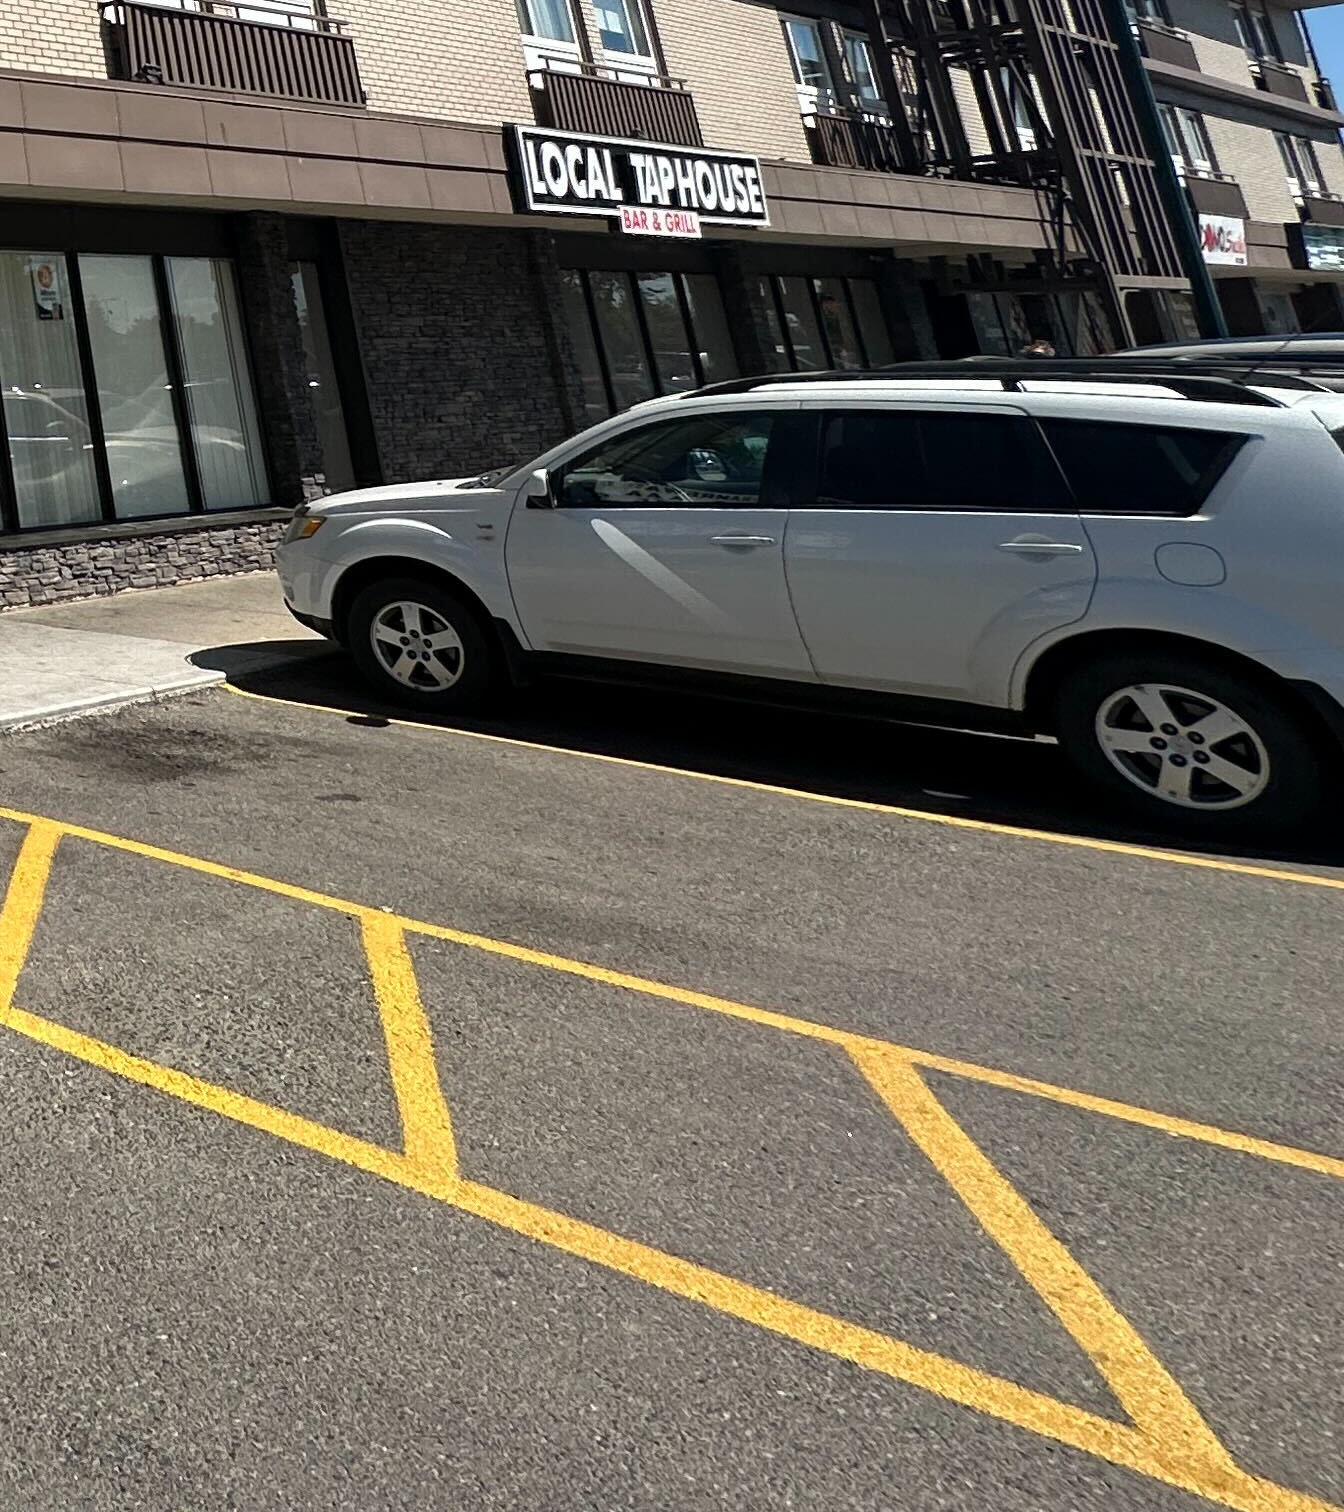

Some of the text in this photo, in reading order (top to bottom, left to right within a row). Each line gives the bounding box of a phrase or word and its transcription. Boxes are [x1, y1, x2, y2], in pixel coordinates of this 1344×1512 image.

[525, 139, 764, 213] LOCAL TAPHOUSE
[623, 208, 698, 234] BAR & GRILL
